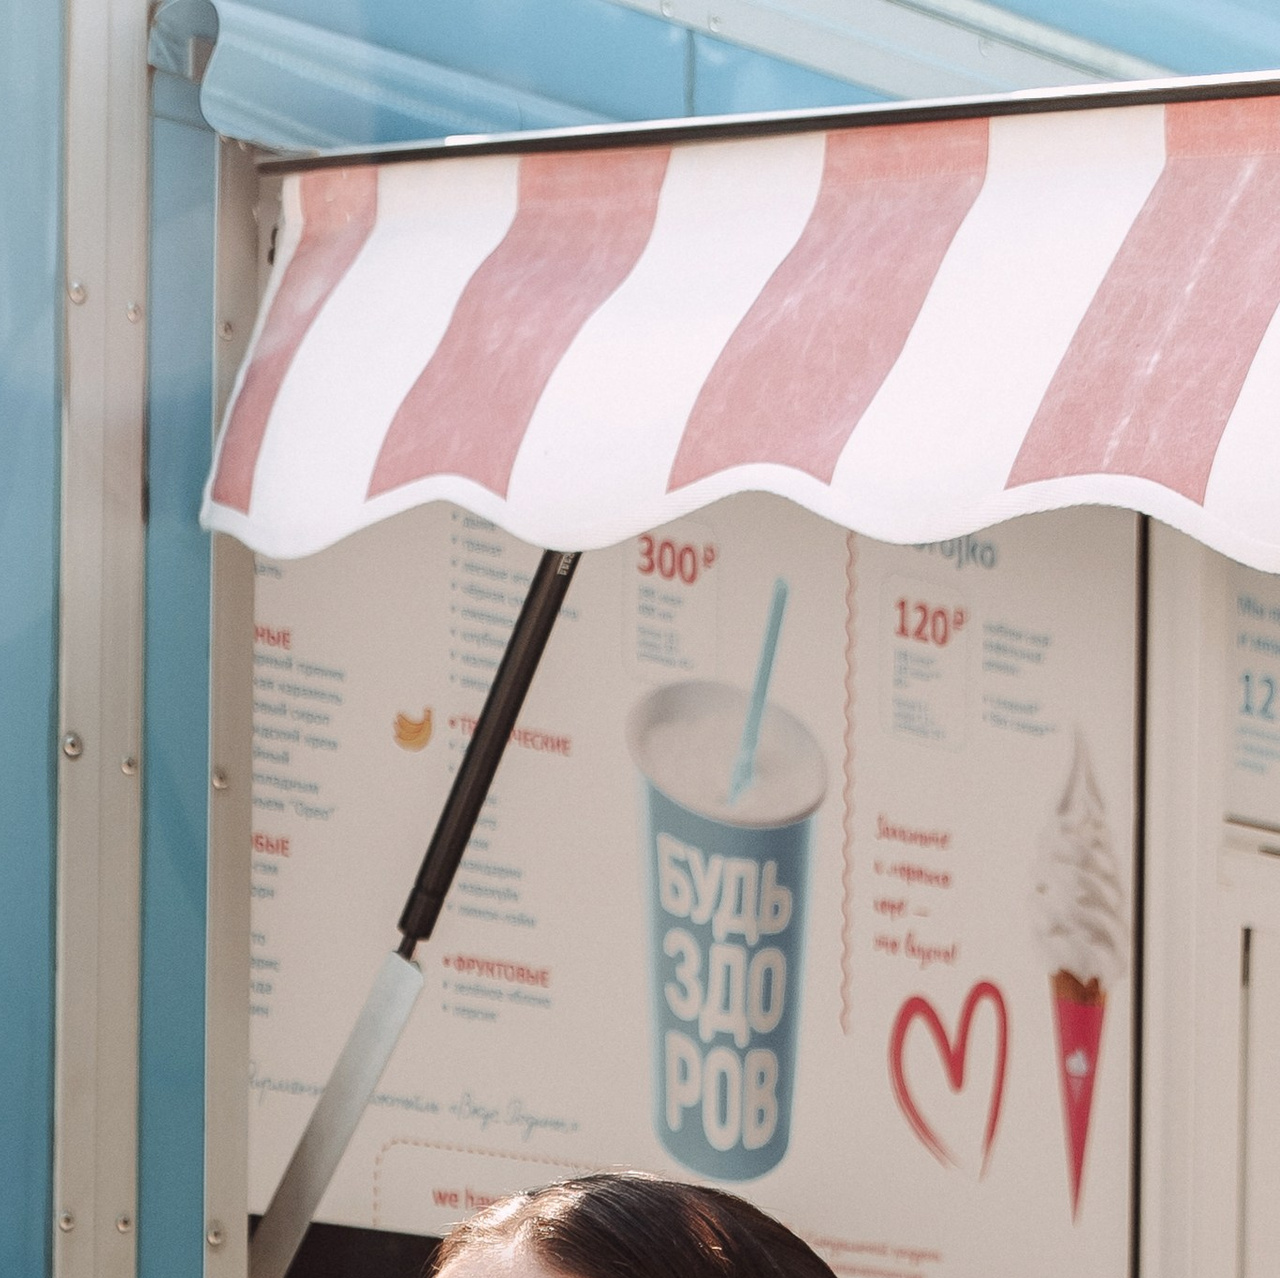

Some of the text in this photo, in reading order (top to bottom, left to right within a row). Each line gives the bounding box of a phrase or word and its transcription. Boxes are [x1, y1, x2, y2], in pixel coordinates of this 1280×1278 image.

[656, 832, 793, 946] БУДЬ
[663, 926, 787, 1049] ЗДО
[664, 1030, 779, 1152] РОВ
